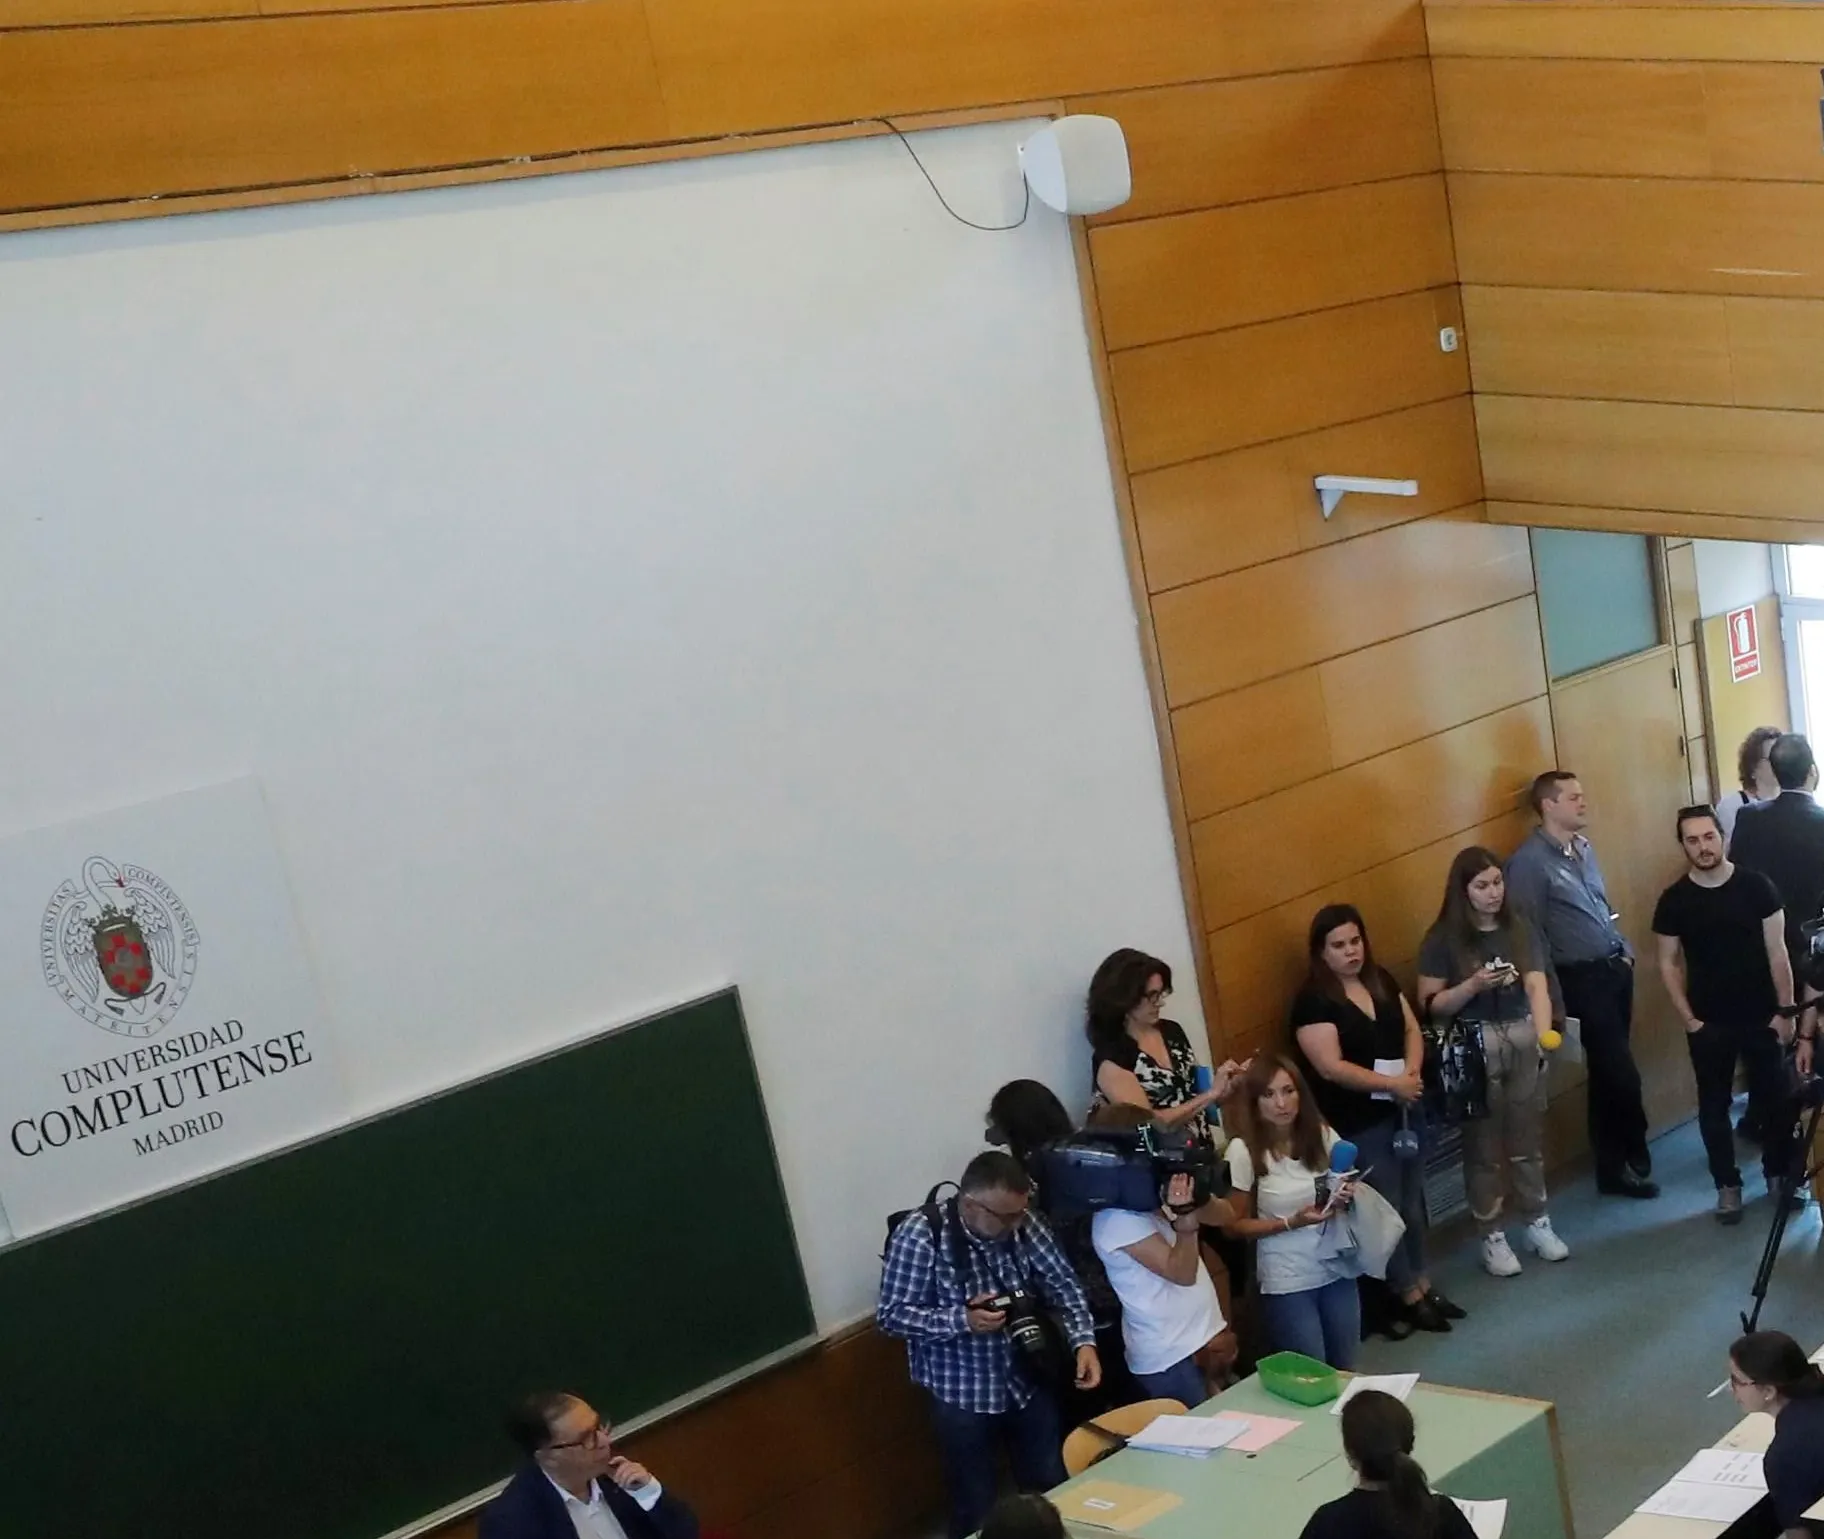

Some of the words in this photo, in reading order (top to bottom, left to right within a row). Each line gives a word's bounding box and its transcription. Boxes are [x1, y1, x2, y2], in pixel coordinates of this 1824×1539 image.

[11, 1030, 313, 1157] COMPLUTENSE
[61, 1019, 244, 1094] UNIVERSIDAD
[132, 1110, 224, 1156] MADRID
